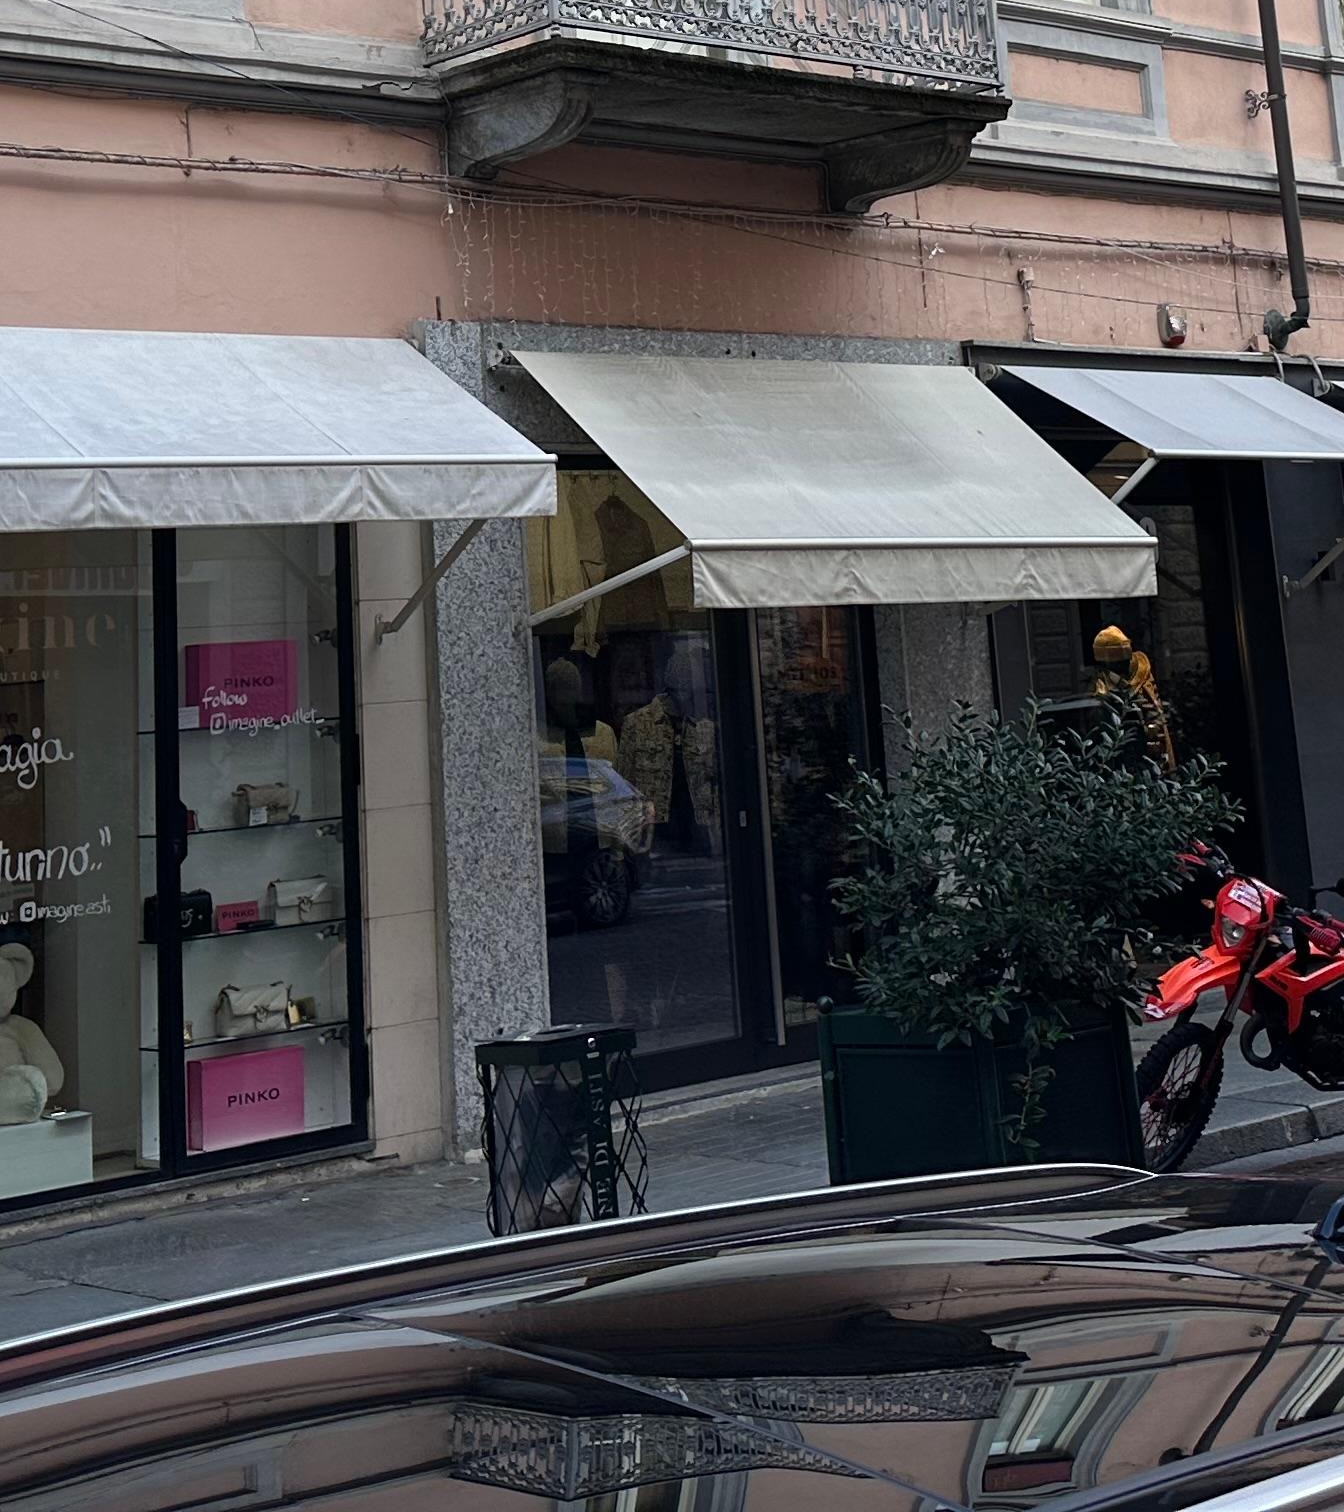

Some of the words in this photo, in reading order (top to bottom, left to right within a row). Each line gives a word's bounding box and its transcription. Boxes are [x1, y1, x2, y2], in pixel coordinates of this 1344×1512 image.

[223, 675, 275, 689] PINKO
[221, 908, 256, 920] PINKO
[227, 1087, 281, 1108] PINKO
